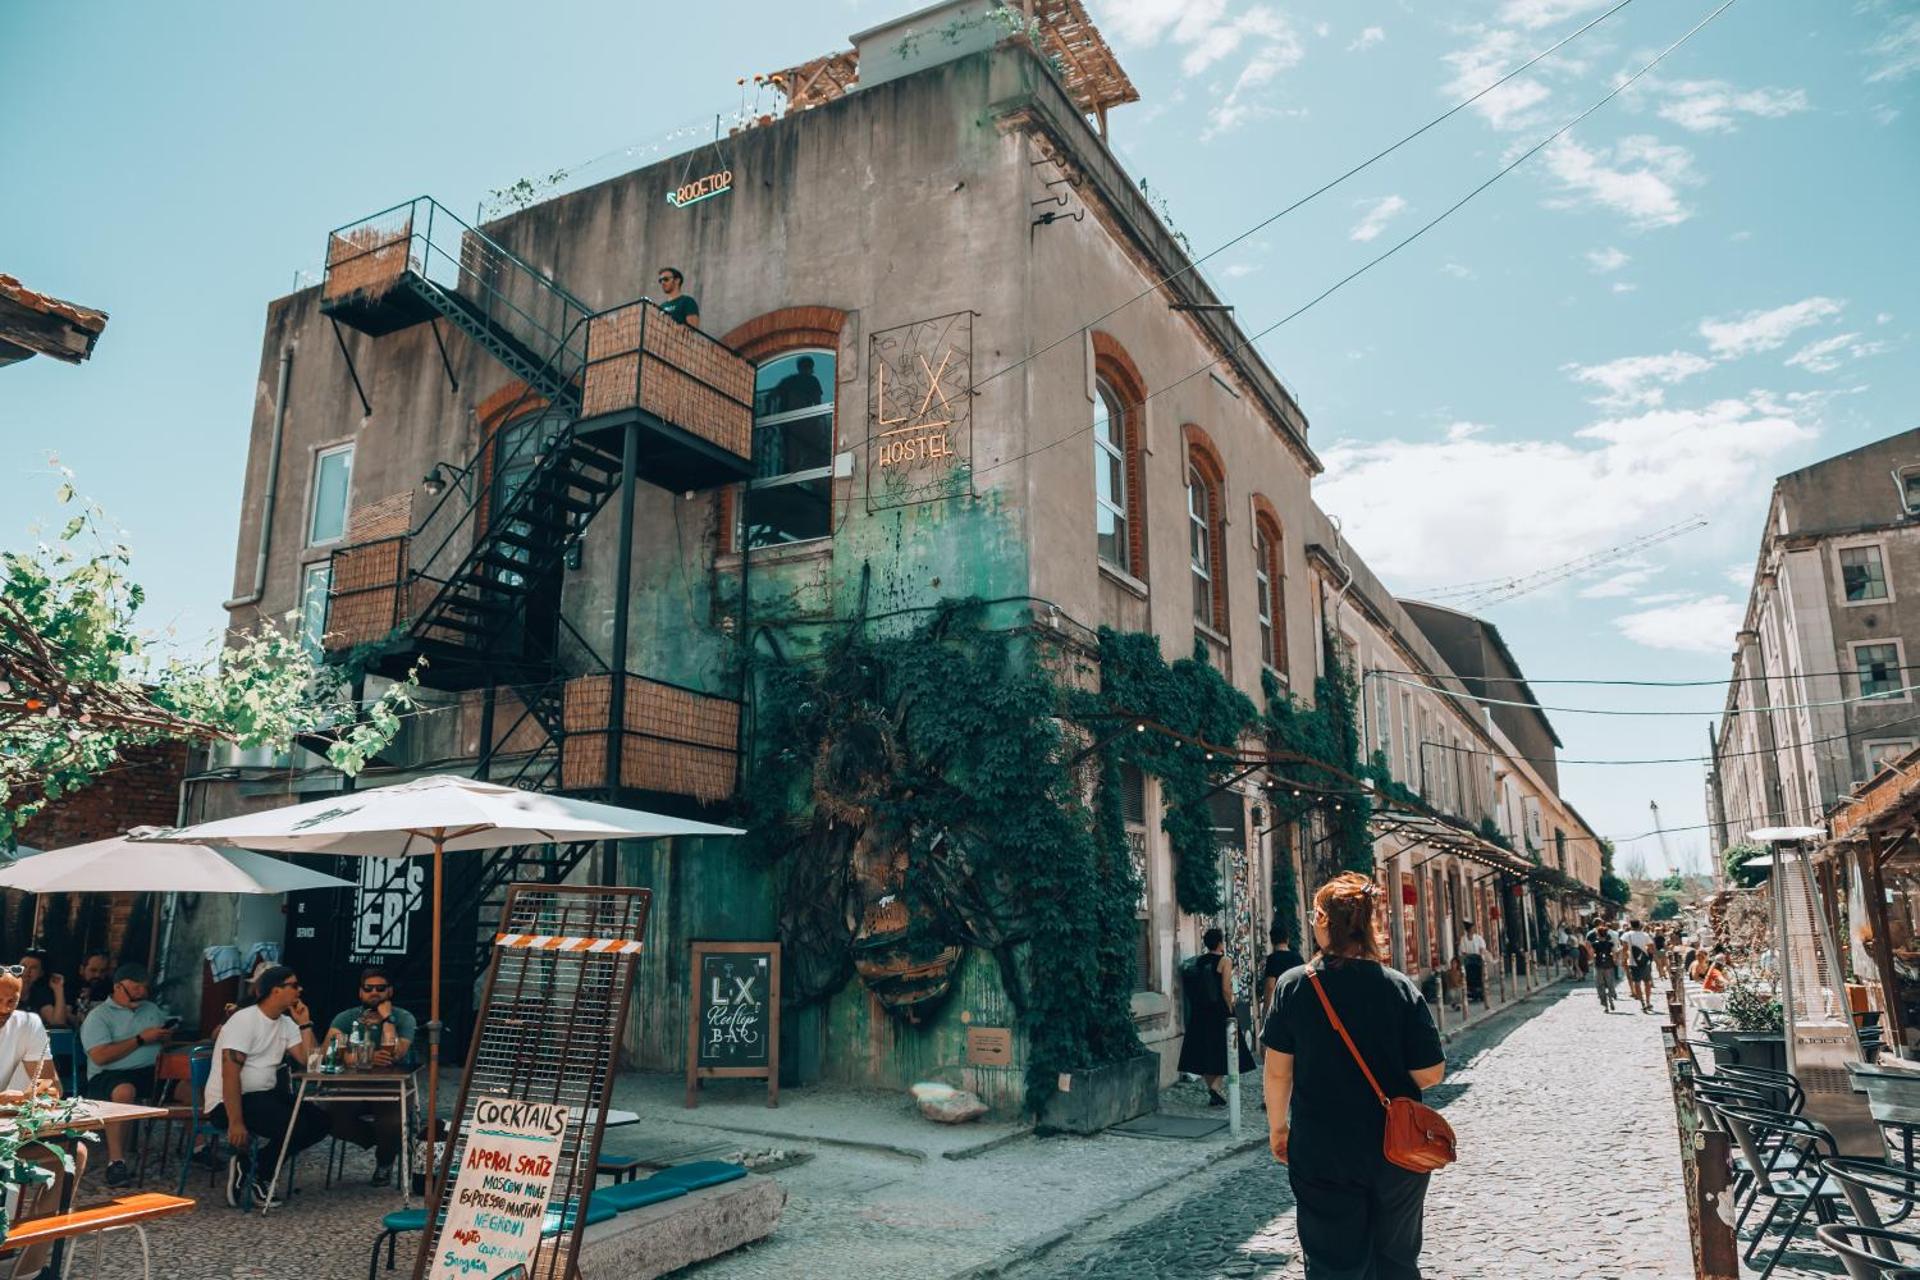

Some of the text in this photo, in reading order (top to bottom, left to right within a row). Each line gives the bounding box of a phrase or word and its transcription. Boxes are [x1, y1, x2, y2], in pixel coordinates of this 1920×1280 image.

[677, 170, 732, 204] ROOFTOP
[878, 350, 952, 425] LX
[879, 433, 953, 466] HOSTEL
[711, 976, 756, 1006] LX
[709, 1027, 758, 1044] BAR
[477, 1100, 567, 1136] COCKTAILS
[482, 1174, 548, 1200] MOSCOW MULE
[473, 1213, 525, 1238] NEGRONI
